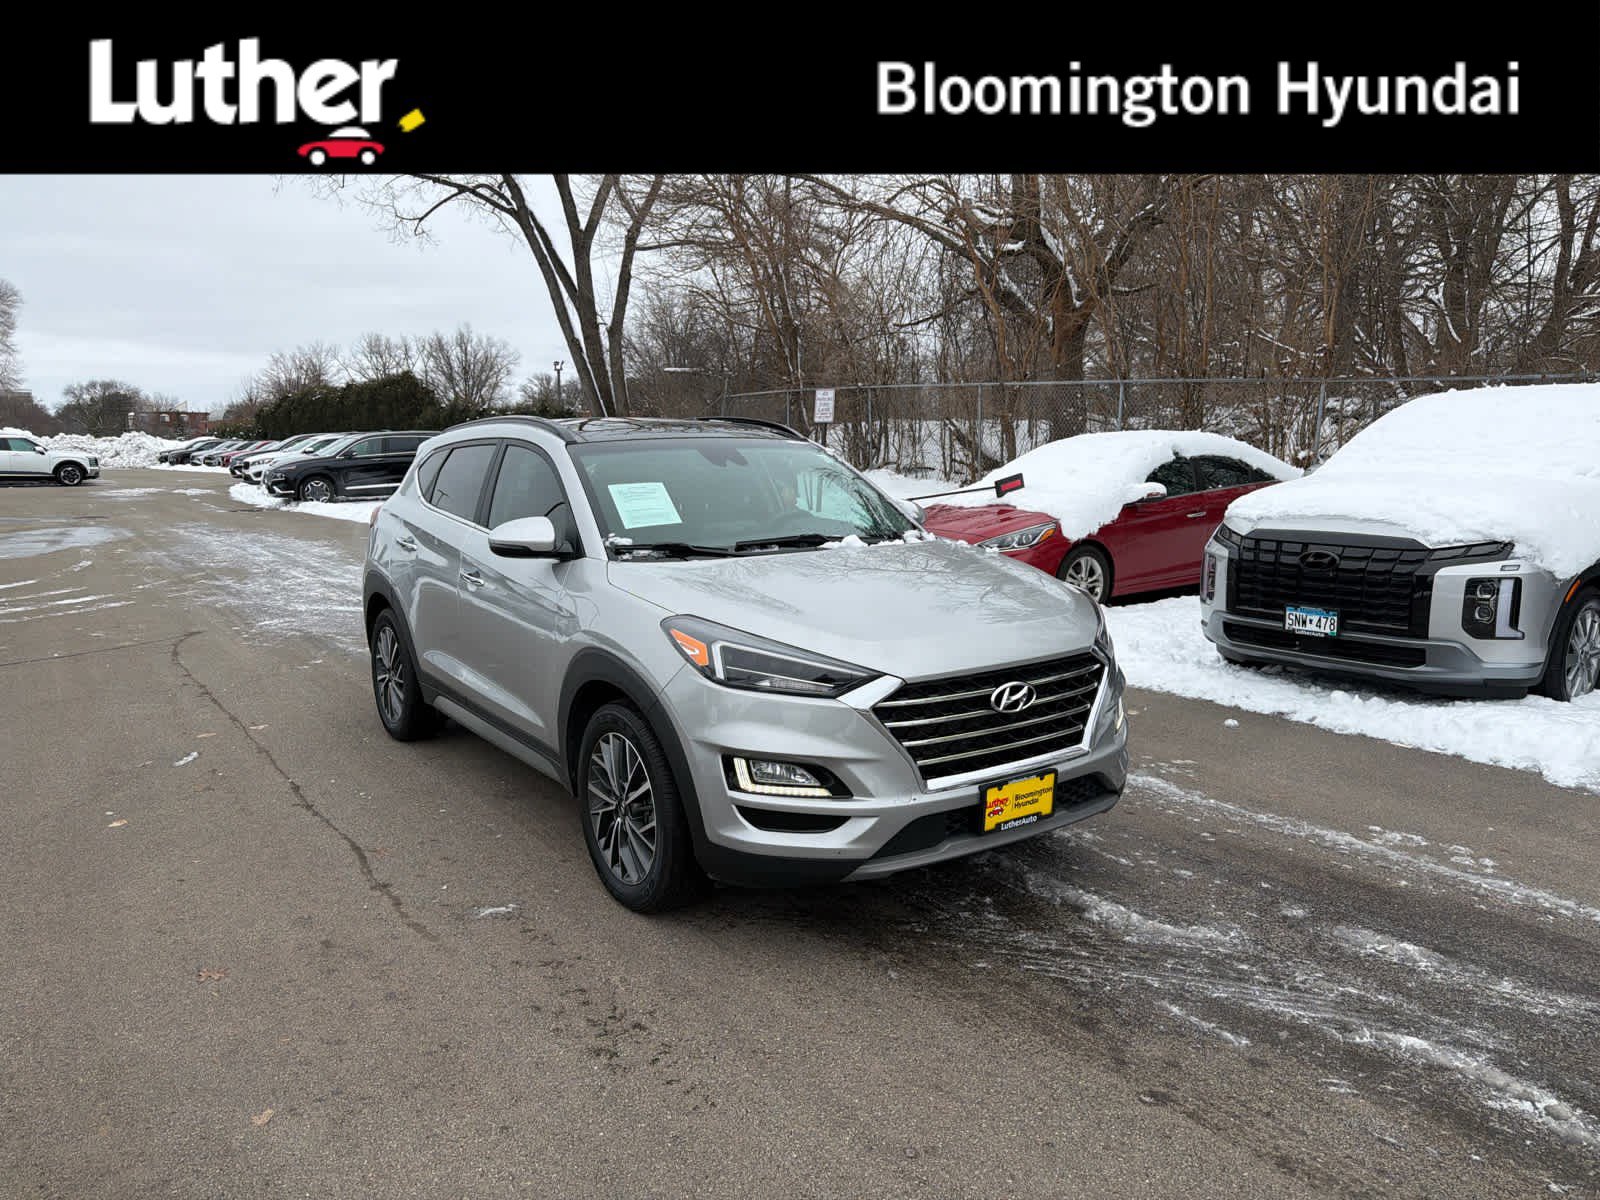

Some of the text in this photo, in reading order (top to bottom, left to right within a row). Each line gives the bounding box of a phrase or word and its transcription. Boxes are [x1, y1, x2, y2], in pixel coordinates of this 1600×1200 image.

[1014, 787, 1053, 802] Bloomington
[1014, 798, 1039, 809] Hyundai
[1001, 815, 1037, 830] LutherAuto
